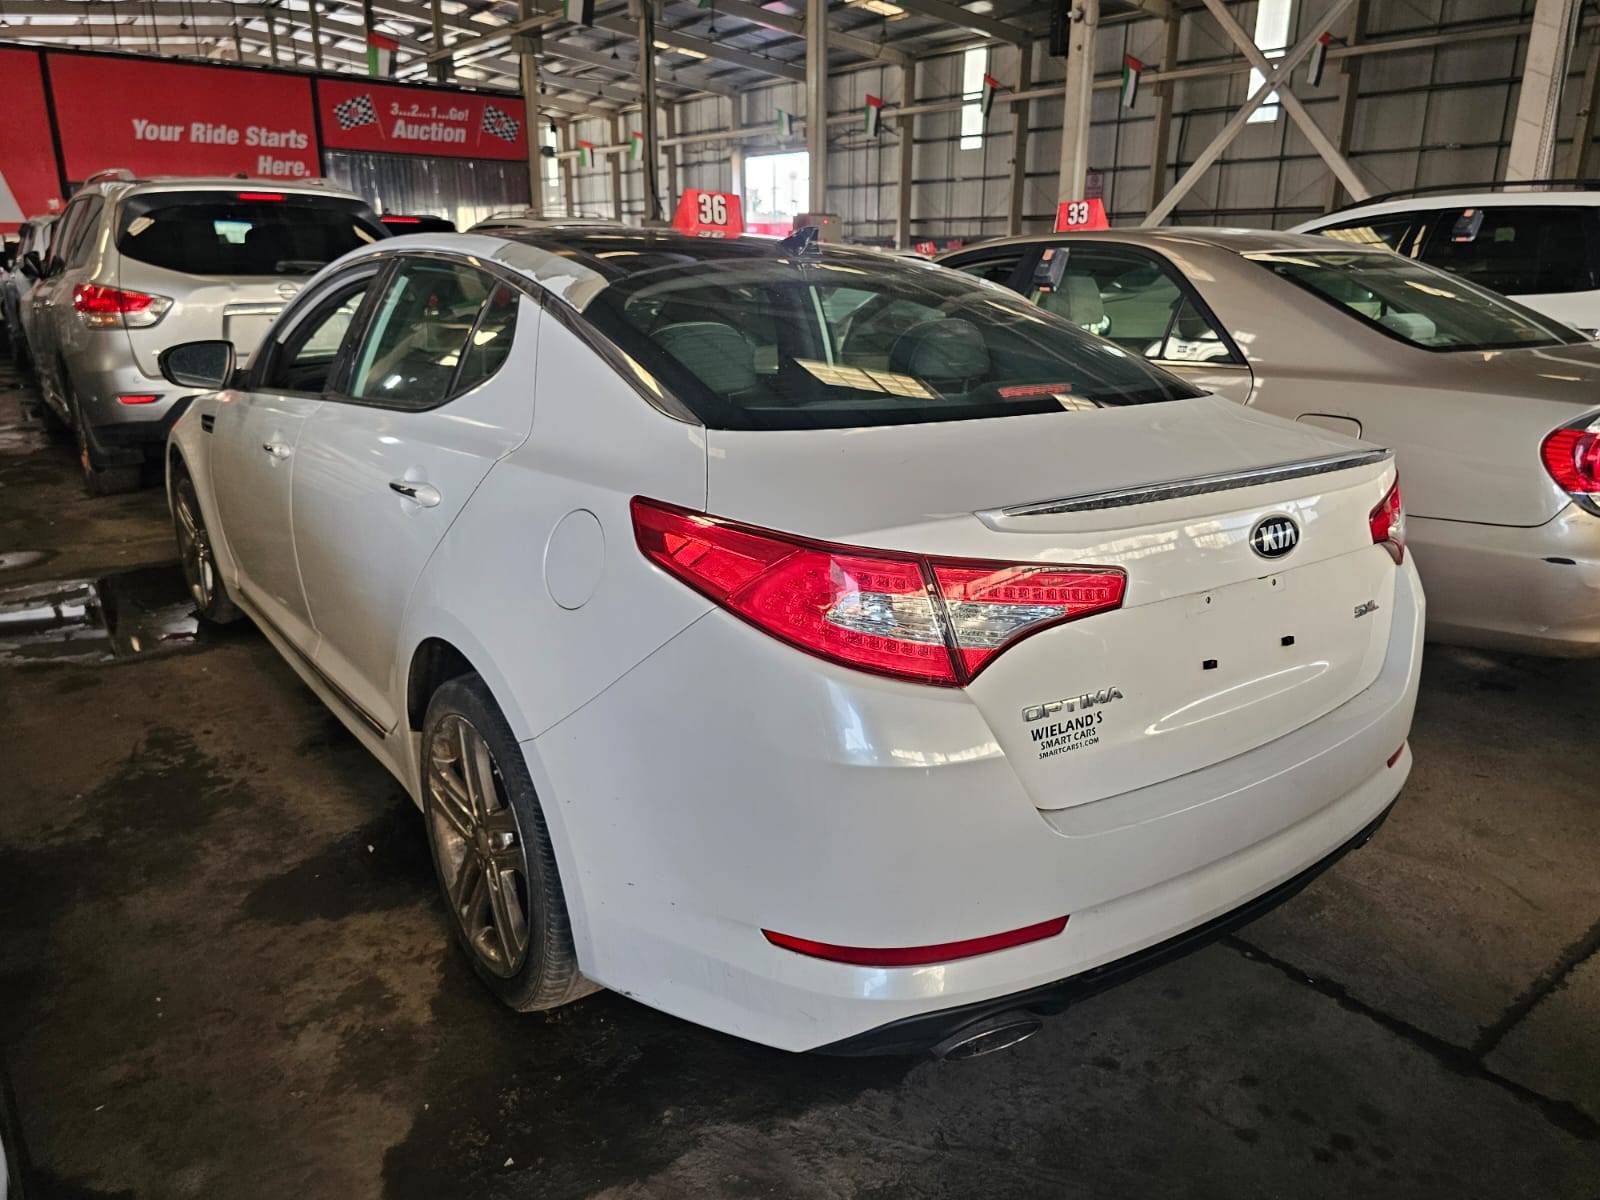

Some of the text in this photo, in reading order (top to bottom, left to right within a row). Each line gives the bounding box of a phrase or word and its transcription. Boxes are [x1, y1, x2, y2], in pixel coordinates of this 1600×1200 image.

[132, 119, 308, 149] Your Ride Starts
[391, 118, 466, 144] Auction
[257, 155, 311, 177] Here.
[698, 193, 727, 225] 36
[1067, 201, 1089, 225] 33
[1260, 521, 1296, 552] KIA
[1022, 686, 1123, 722] OPTIMA
[1031, 710, 1103, 742] WIELAND'S
[1040, 727, 1096, 751] SMART CARS
[1038, 736, 1100, 760] SMARTCARS1.COM
